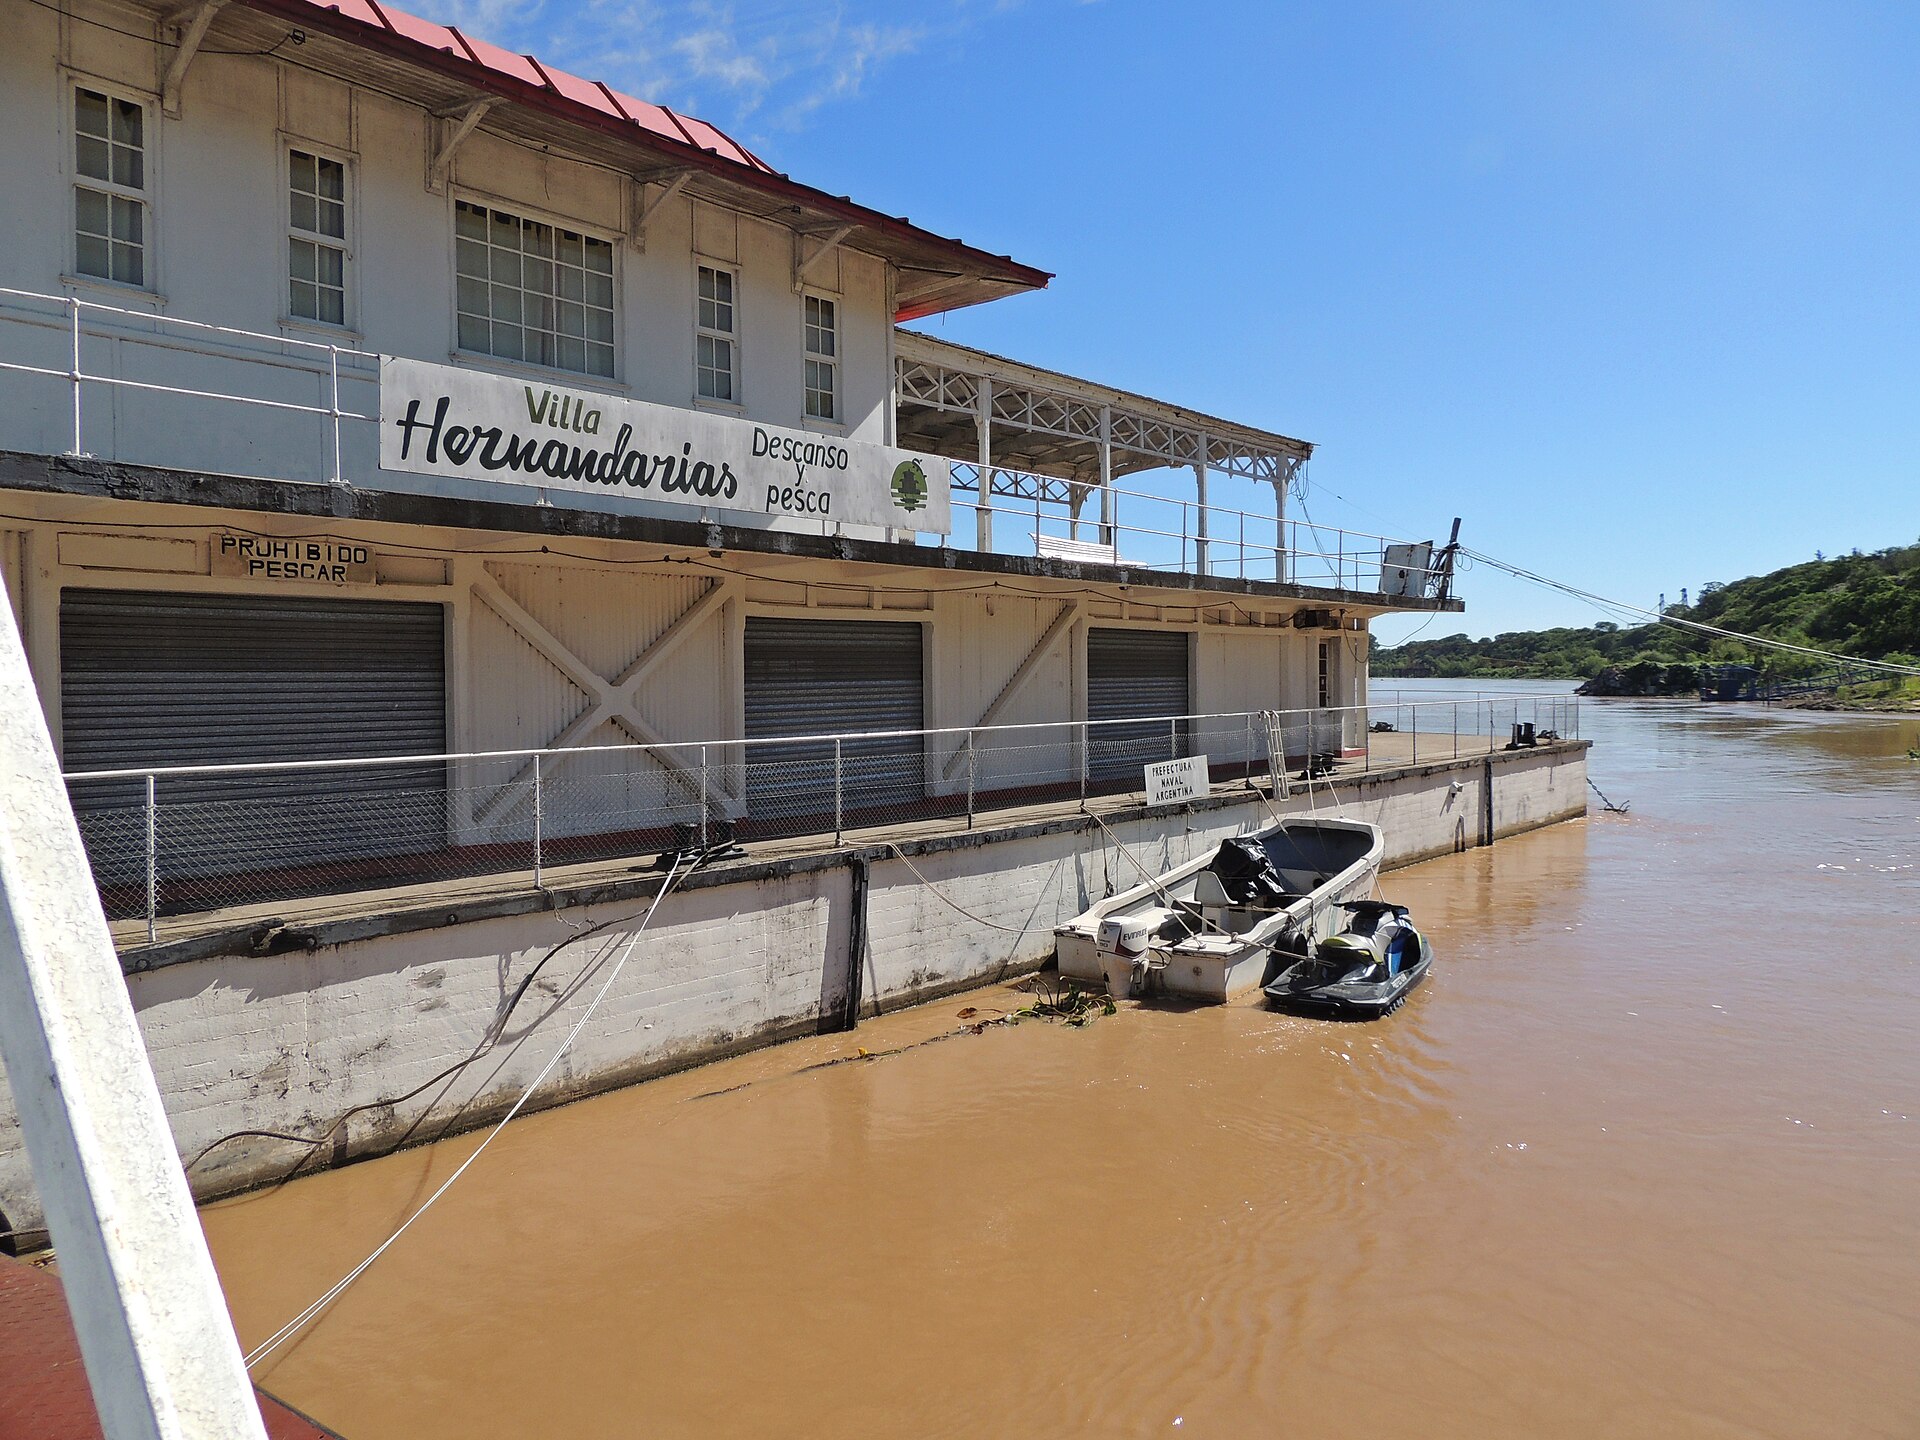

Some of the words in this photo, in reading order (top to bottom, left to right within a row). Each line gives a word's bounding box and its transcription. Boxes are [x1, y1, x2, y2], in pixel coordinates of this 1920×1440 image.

[524, 386, 601, 435] Villa
[396, 396, 738, 500] Hernandarias
[752, 426, 848, 471] Descanso
[794, 463, 805, 487] y
[765, 484, 831, 515] pesca
[250, 559, 346, 582] PESCAR
[1152, 762, 1192, 777] PREFECTURA
[1155, 786, 1193, 801] ARGENTINA
[1161, 776, 1183, 788] NAVAL
